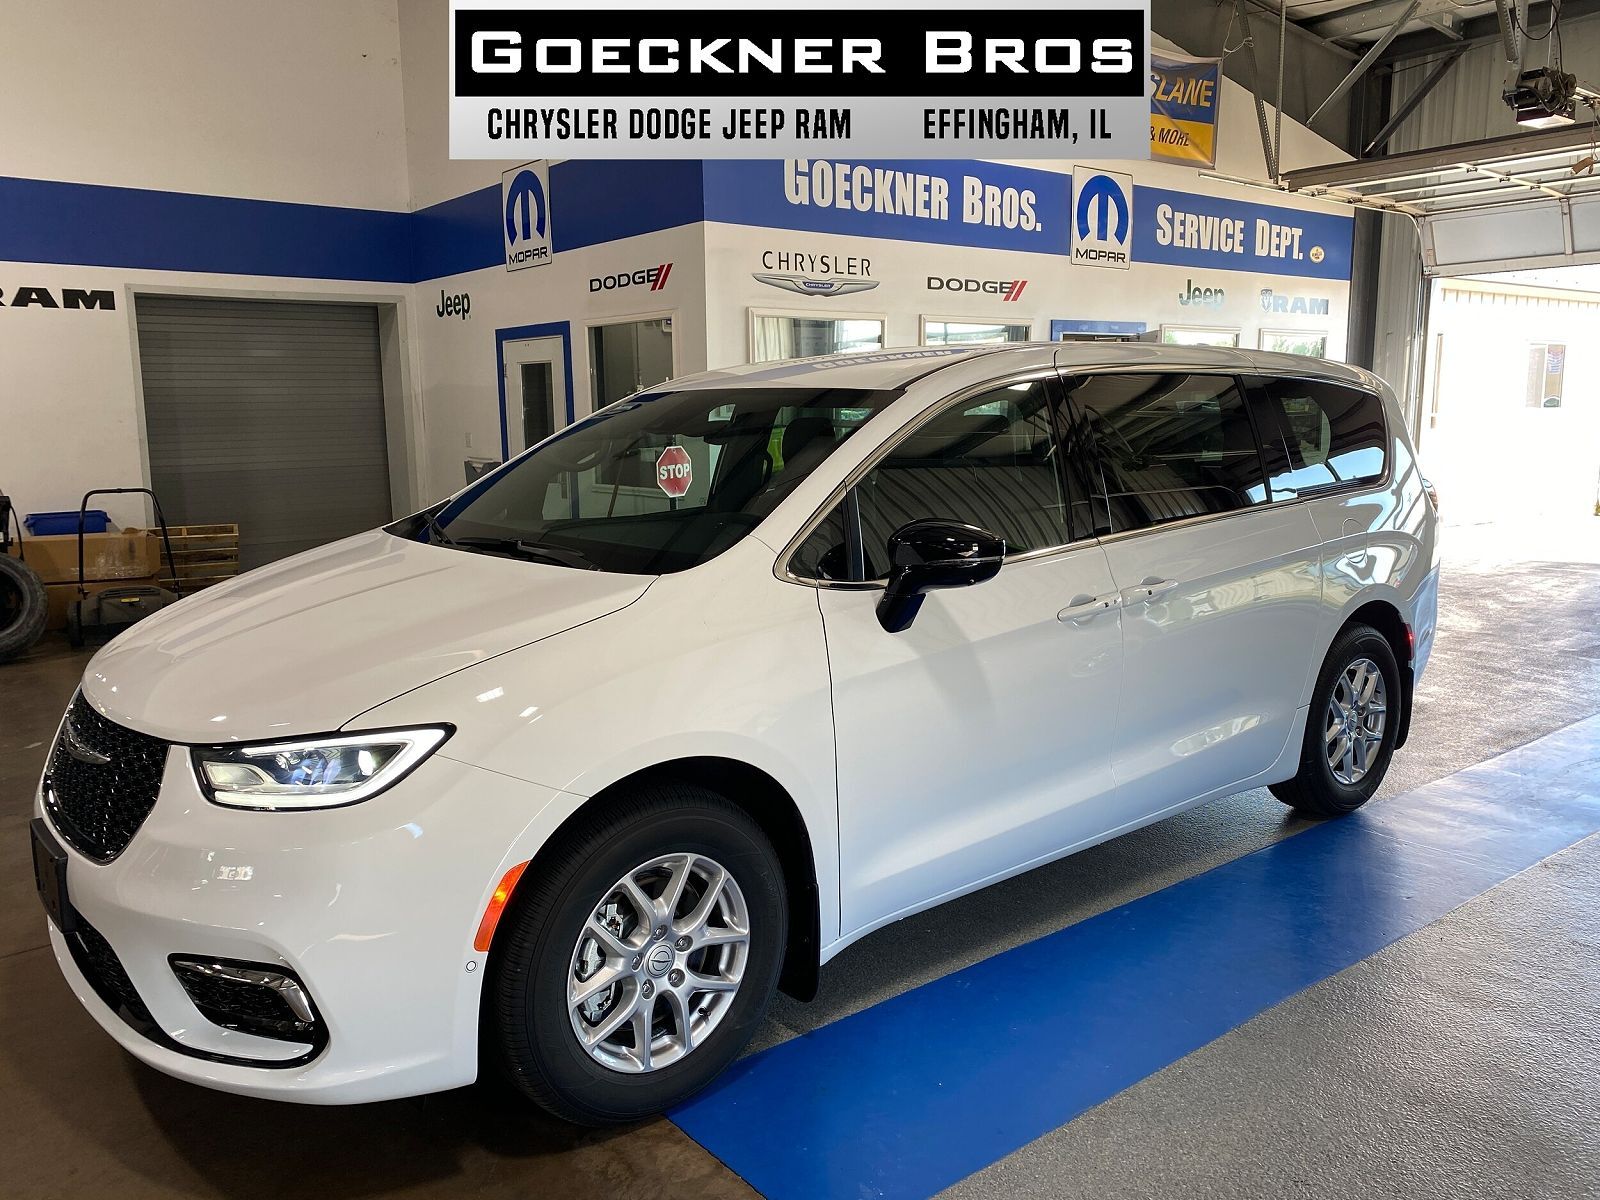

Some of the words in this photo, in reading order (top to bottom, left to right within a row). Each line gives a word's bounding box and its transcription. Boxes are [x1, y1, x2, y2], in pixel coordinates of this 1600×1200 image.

[1158, 128, 1190, 147] MORE
[963, 175, 1042, 233] BROS.
[1156, 203, 1244, 253] SERVICE
[1255, 219, 1303, 261] DEPT.
[508, 246, 548, 265] MOPAR
[762, 250, 871, 276] CHRYSLER
[1075, 247, 1126, 264] MOPAR
[589, 267, 660, 293] DODGE
[927, 276, 1014, 296] DODGE
[0, 286, 116, 310] AM
[436, 289, 471, 321] Jeep
[1272, 295, 1329, 315] RAM
[659, 463, 690, 480] STOP
